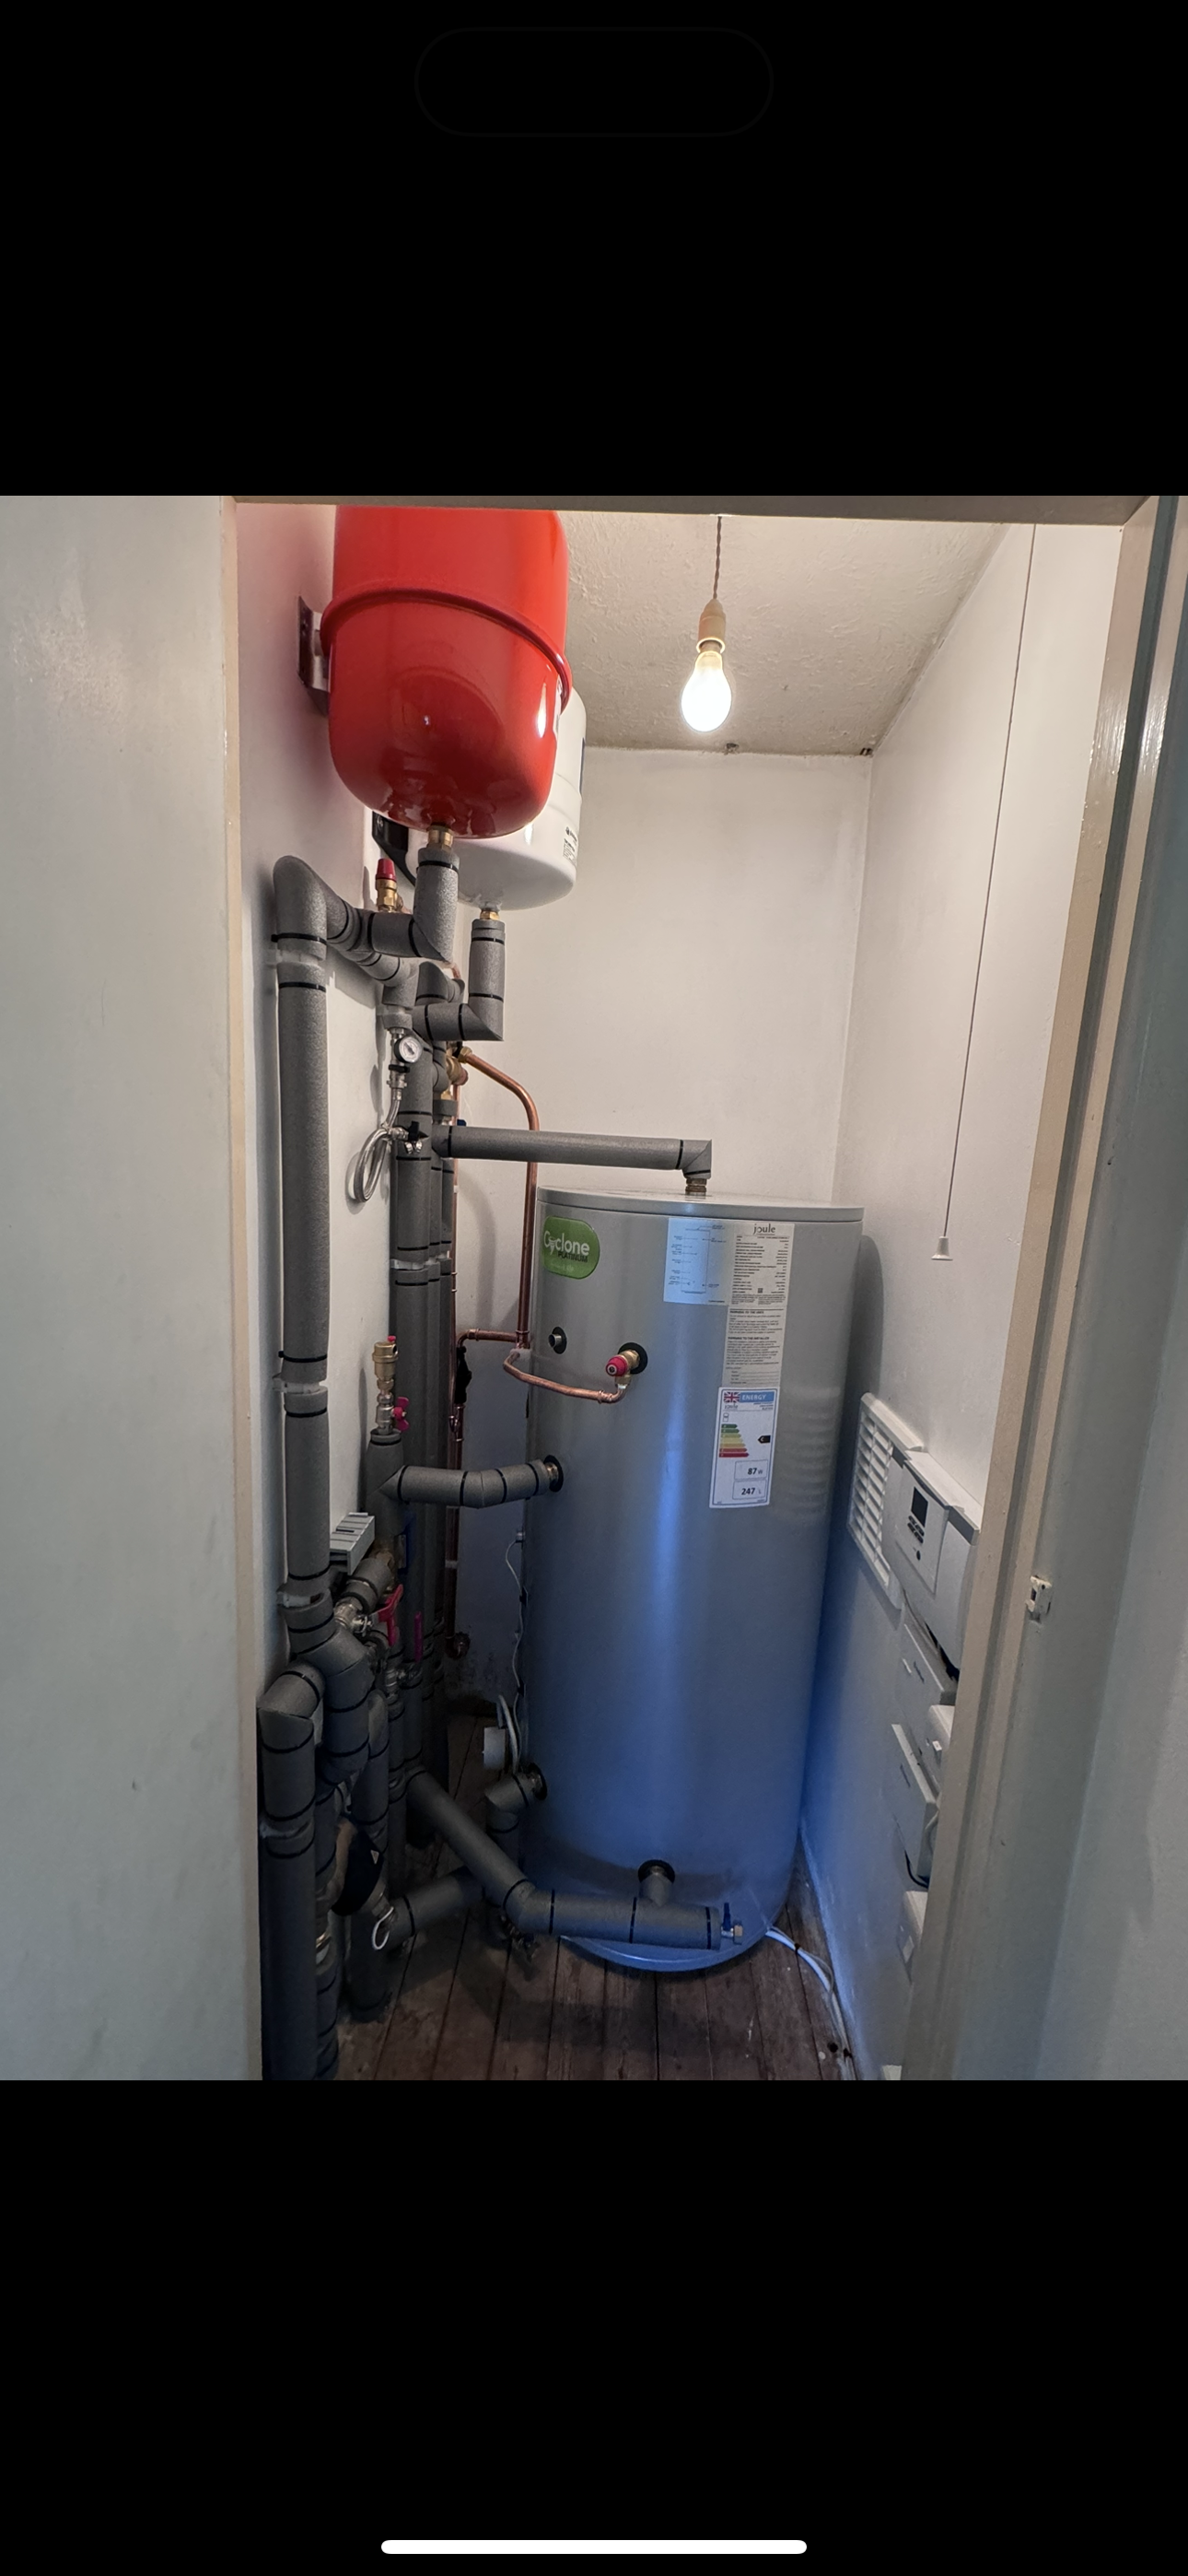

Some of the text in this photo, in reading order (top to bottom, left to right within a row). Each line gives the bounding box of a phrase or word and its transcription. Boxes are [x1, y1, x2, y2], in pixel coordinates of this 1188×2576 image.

[752, 1223, 775, 1235] joule
[543, 1230, 590, 1256] Cyclone
[557, 1250, 588, 1263] PLATINUM
[741, 1487, 755, 1495] 247
